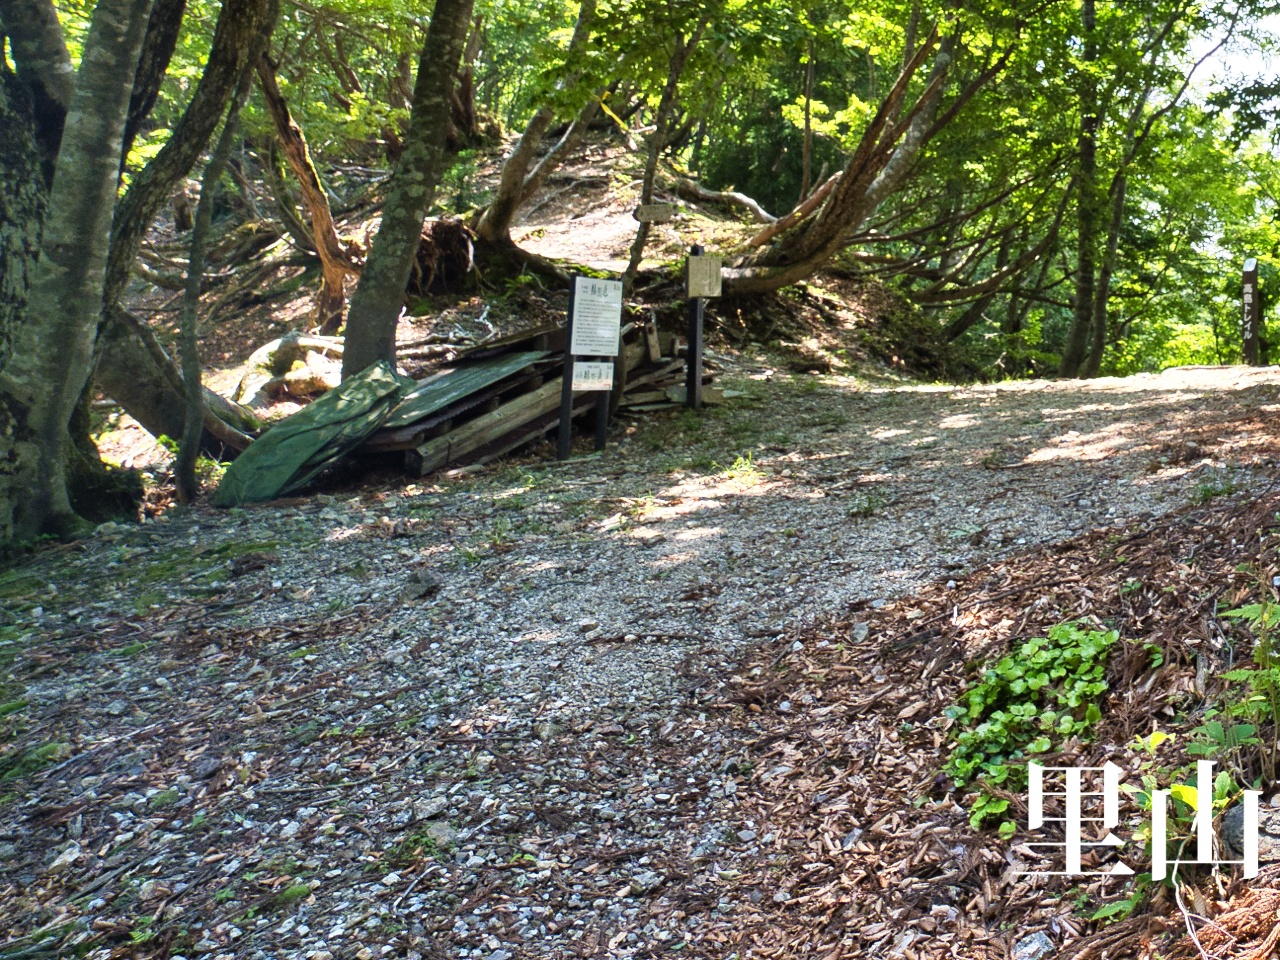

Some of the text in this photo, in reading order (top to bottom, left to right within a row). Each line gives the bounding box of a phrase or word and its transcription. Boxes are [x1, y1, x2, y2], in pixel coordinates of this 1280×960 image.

[1243, 283, 1253, 339] 高島トレイル
